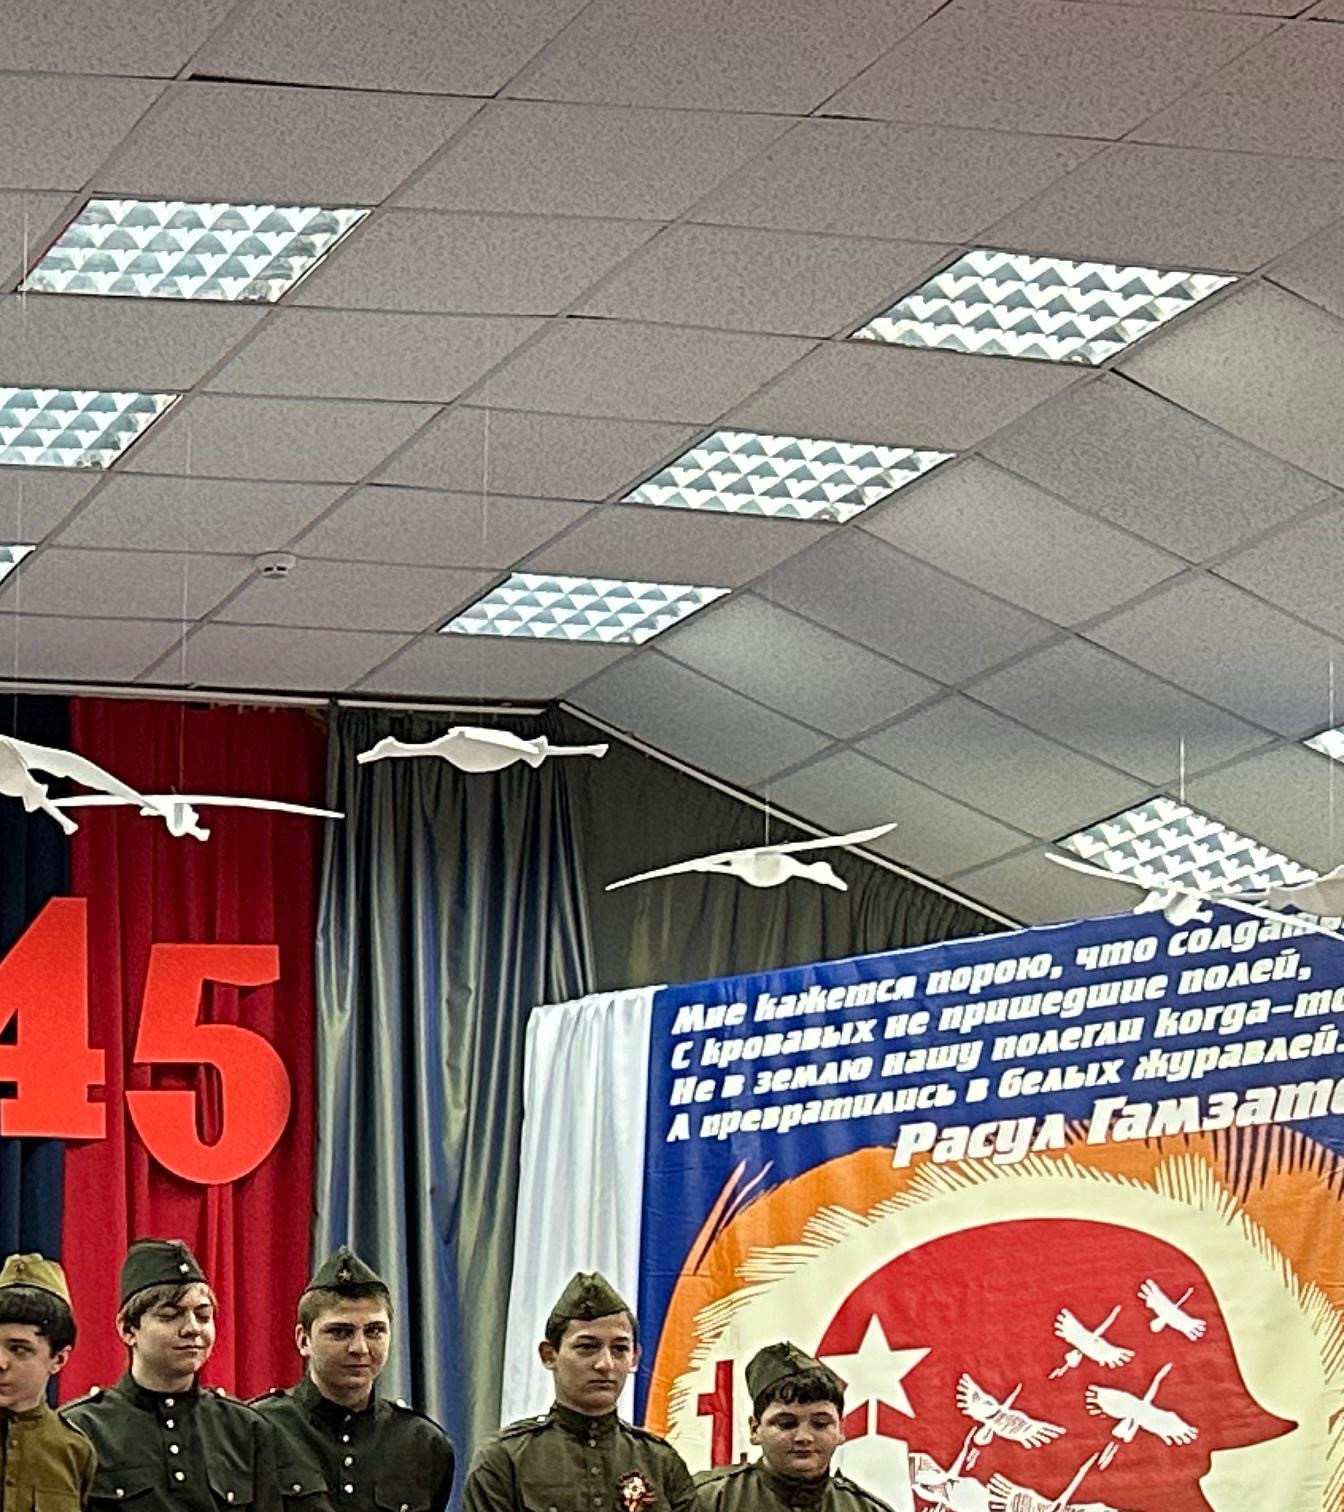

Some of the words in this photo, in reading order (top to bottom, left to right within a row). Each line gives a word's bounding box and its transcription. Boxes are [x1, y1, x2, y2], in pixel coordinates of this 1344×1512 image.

[670, 1040, 694, 1071] С
[700, 1017, 879, 1069] кровавых
[883, 1010, 931, 1040] не
[937, 973, 1169, 1034] пришедшие
[1177, 948, 1312, 996] полей,
[671, 1001, 747, 1036] Мне
[754, 975, 918, 1023] кажется
[925, 952, 1064, 996] порою,
[1075, 936, 1158, 972] что
[666, 1112, 690, 1143] А
[699, 1081, 957, 1141] превратились
[965, 1077, 990, 1104] в
[997, 1058, 1125, 1099] белых
[669, 1075, 716, 1107] Не
[720, 1073, 746, 1098] в
[752, 1055, 874, 1095] землю
[880, 1039, 984, 1077] нашу
[990, 1016, 1146, 1062] полегли
[891, 1112, 1067, 1169] Расул
